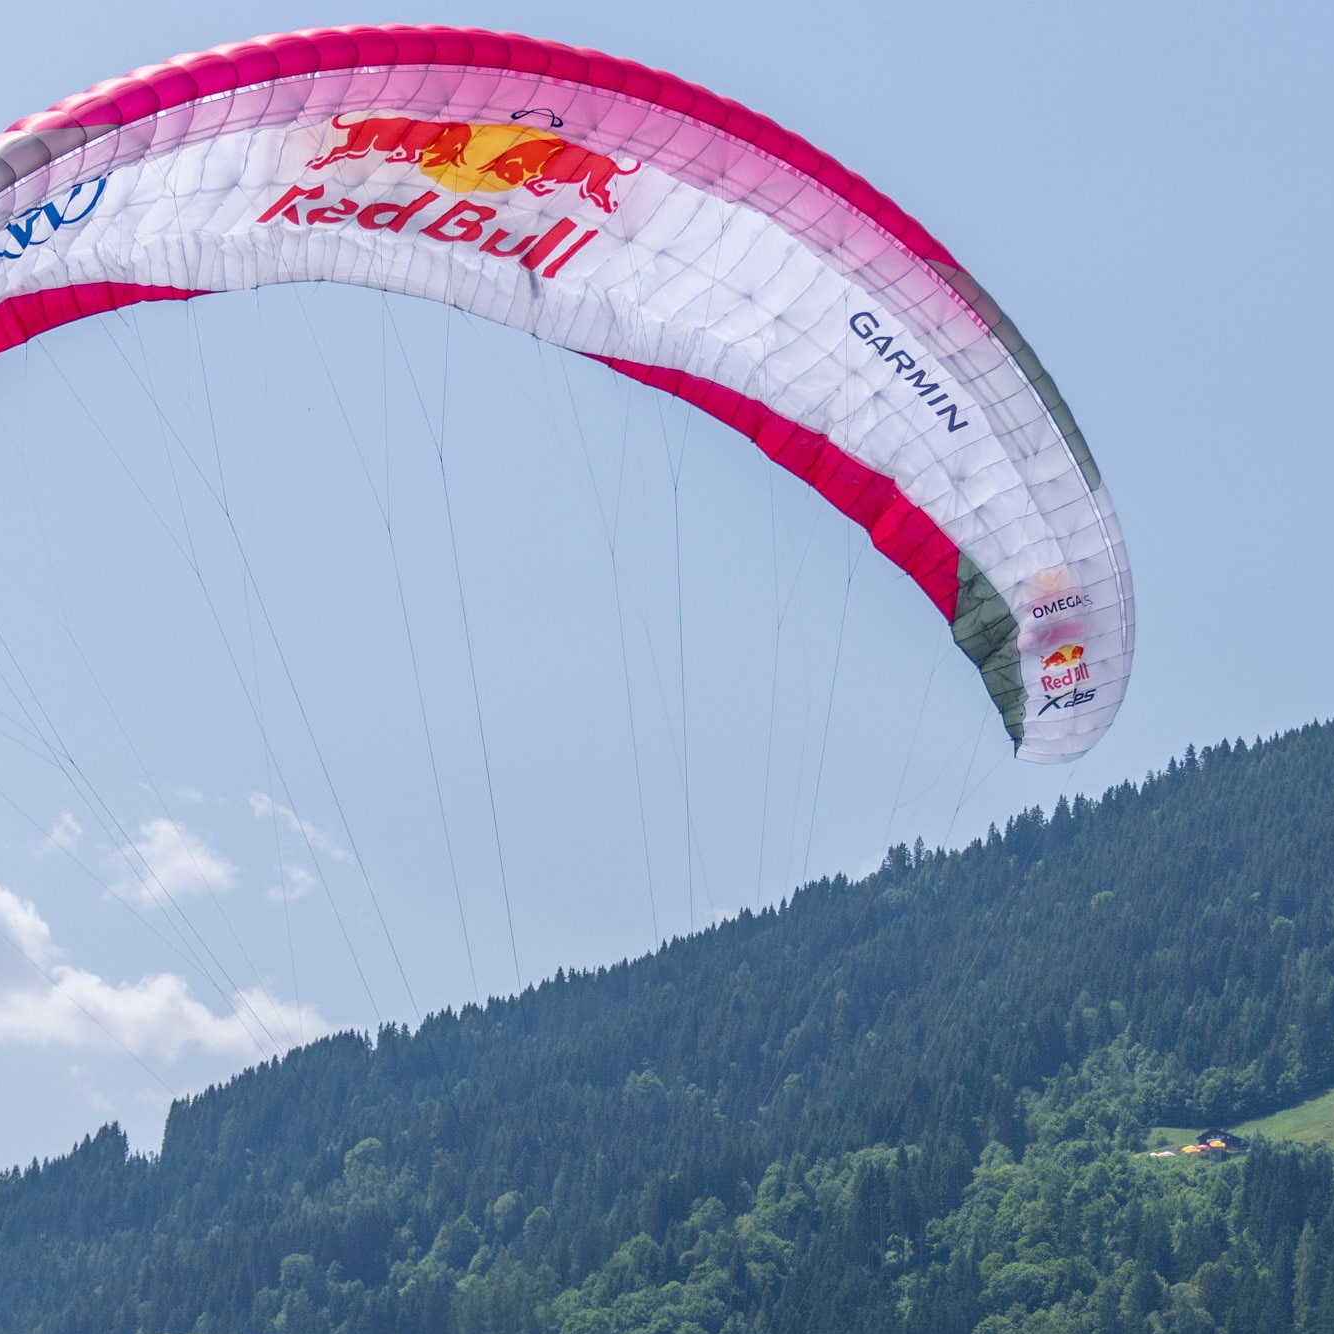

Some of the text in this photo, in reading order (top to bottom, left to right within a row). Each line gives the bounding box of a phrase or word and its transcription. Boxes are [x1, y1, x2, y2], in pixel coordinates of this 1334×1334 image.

[255, 183, 600, 280] Red Bull
[849, 311, 969, 433] GARMIN
[1040, 668, 1073, 692] Red
